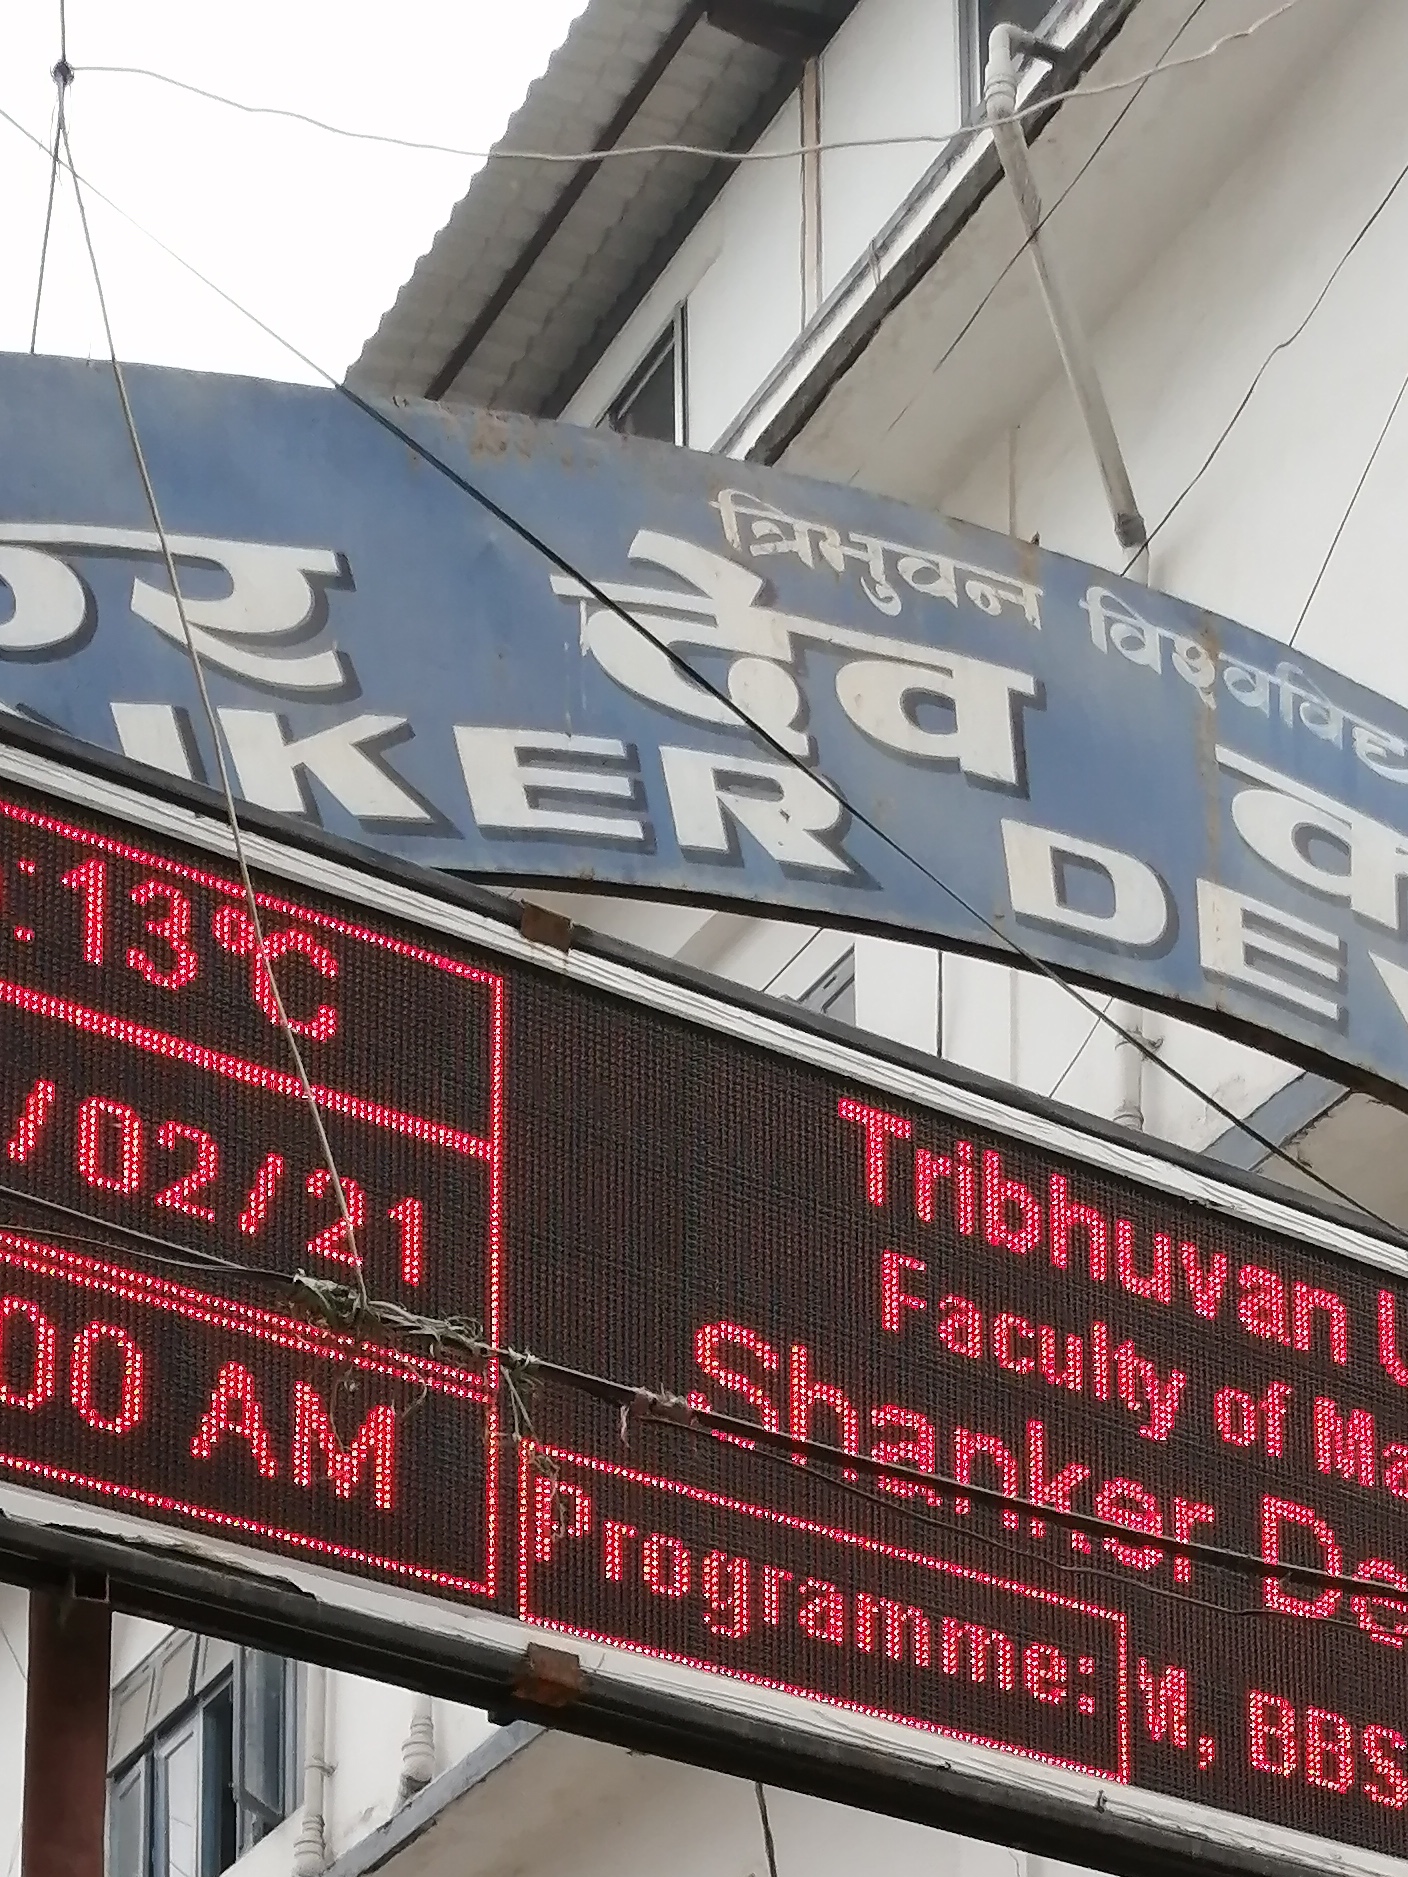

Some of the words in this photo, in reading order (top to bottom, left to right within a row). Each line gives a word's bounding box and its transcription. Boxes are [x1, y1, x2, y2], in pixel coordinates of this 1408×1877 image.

[552, 528, 1039, 788] देव
[708, 488, 1044, 630] त्रिभुवन
[838, 1096, 1349, 1366] Tribhuvan
[191, 1360, 398, 1512] AM
[689, 1319, 1216, 1584] Shanker
[882, 1248, 1189, 1442] Faculty
[1213, 1382, 1293, 1458] of
[533, 1477, 1097, 1716] Programme:
